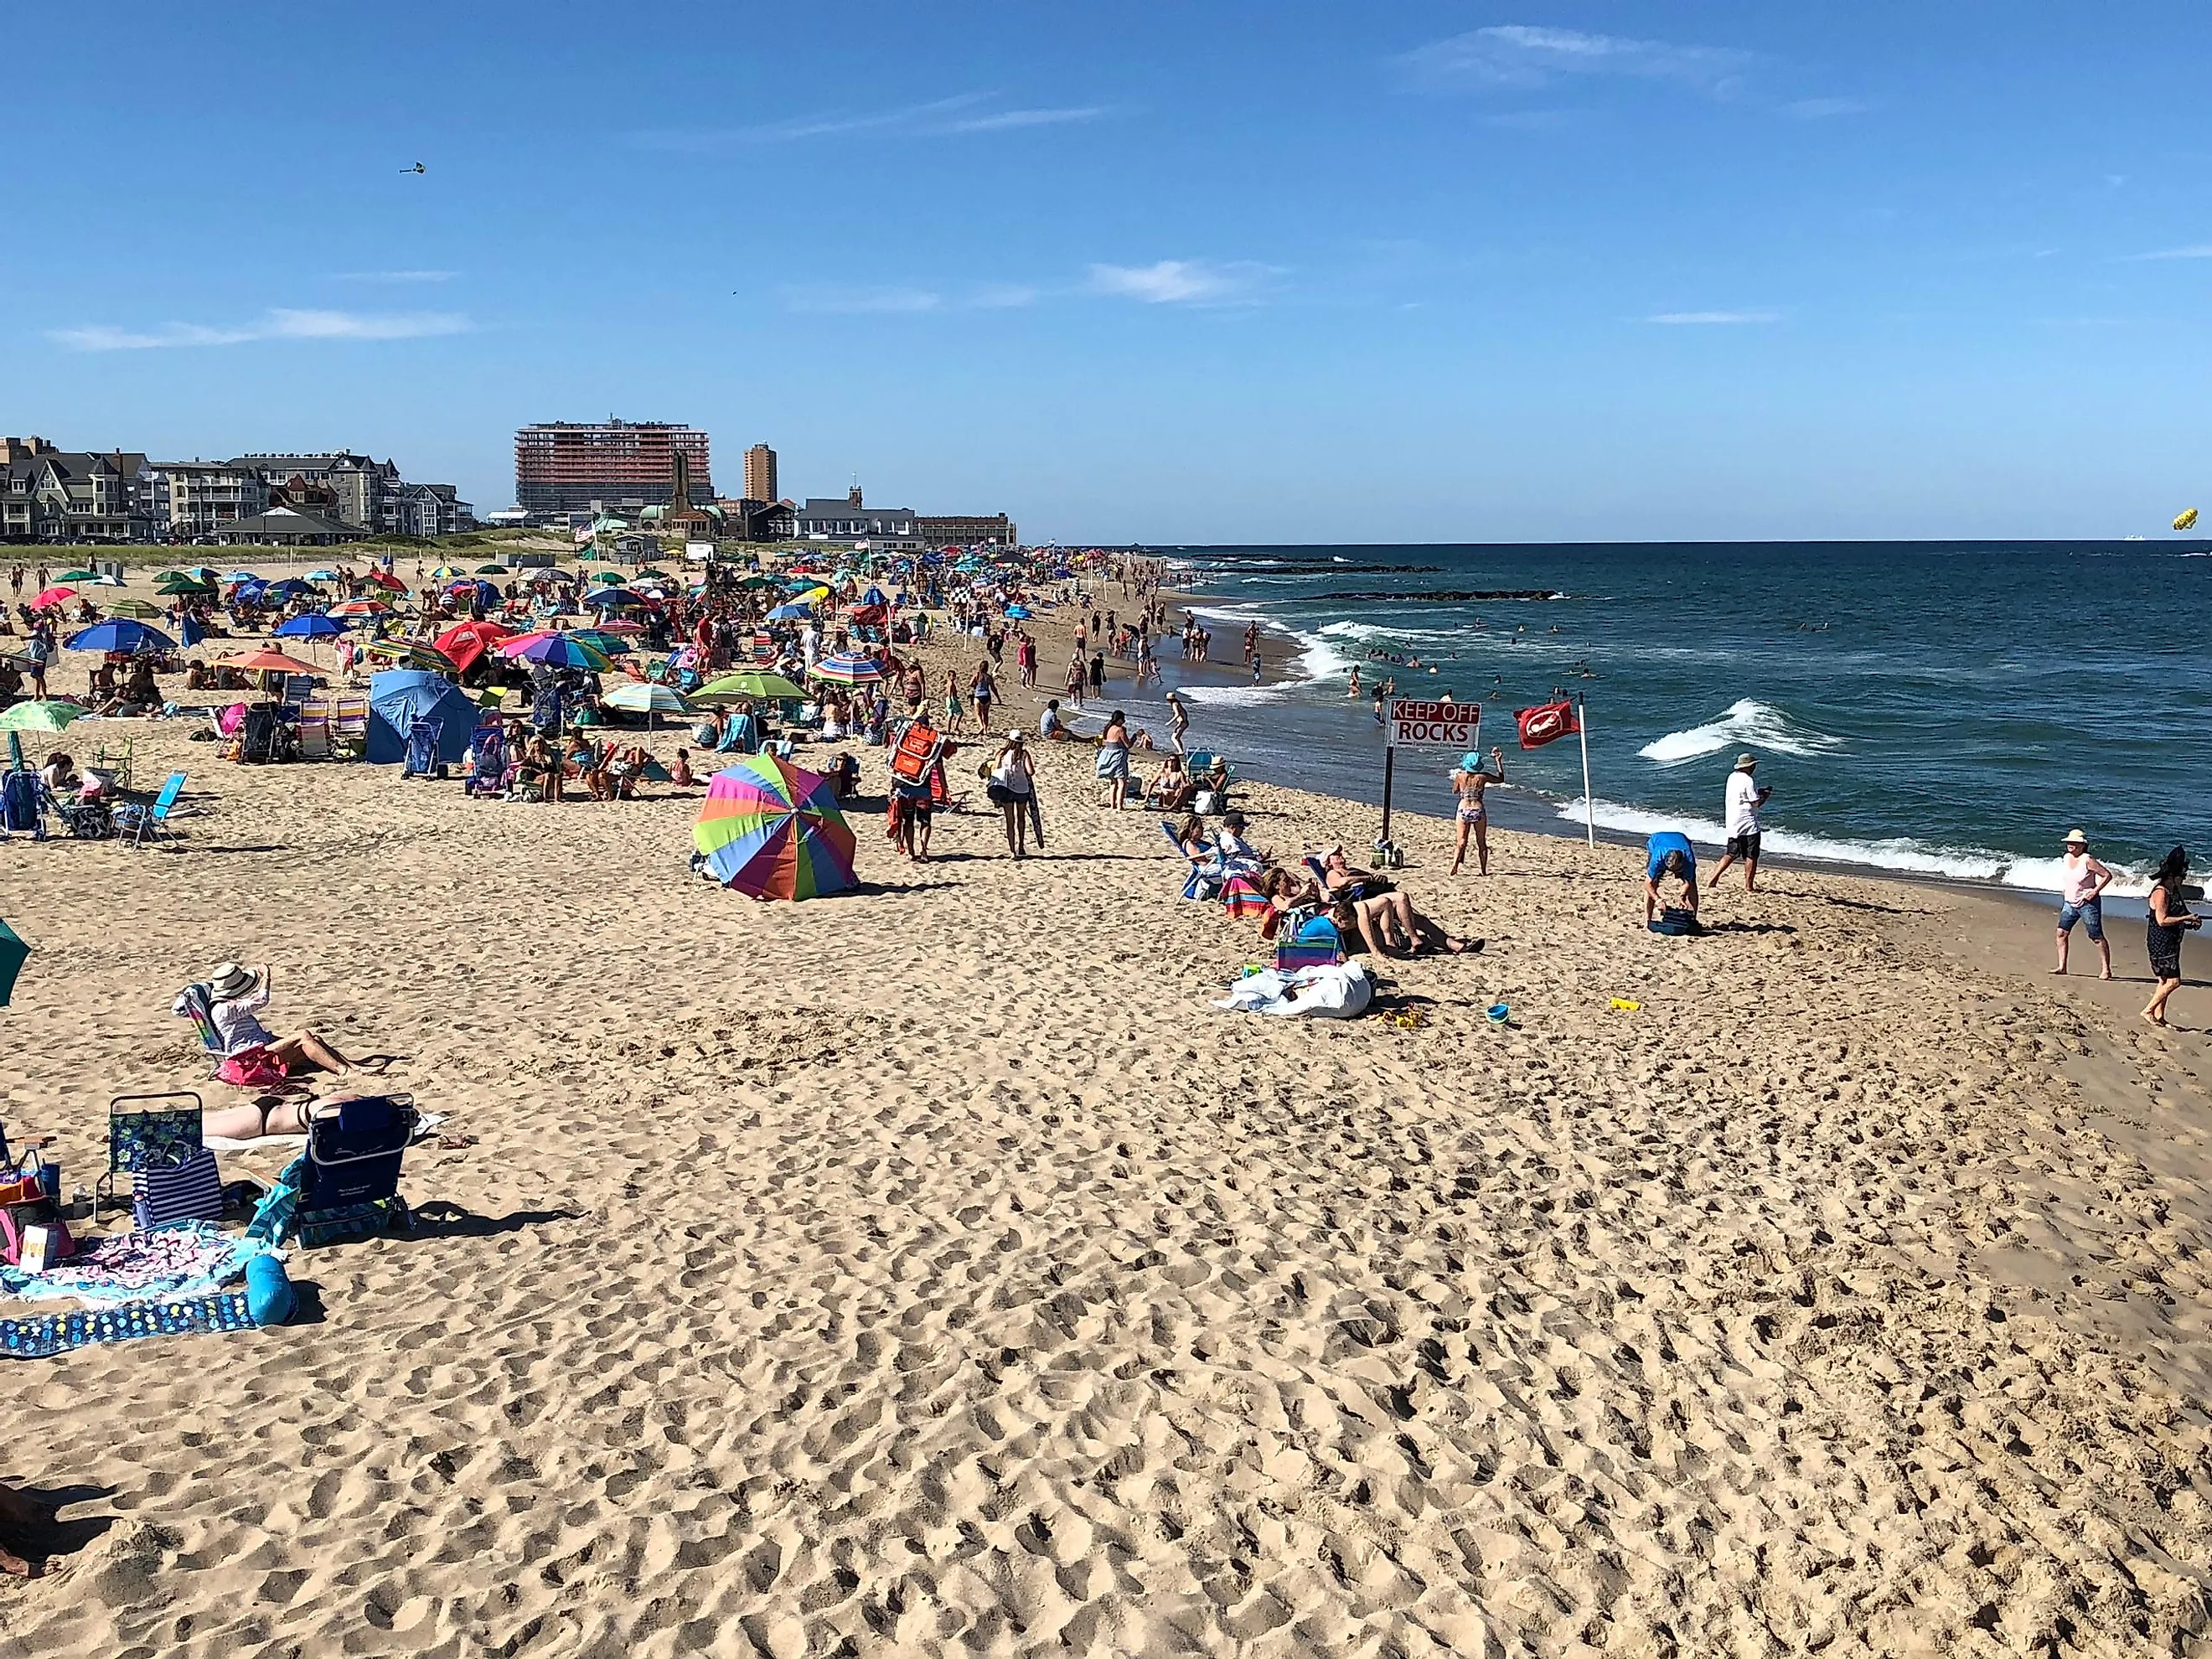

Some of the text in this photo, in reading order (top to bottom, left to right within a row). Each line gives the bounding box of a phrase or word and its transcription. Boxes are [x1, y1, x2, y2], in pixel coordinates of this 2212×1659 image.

[1392, 700, 1480, 721] KEEP OFF
[1398, 721, 1469, 742] ROCKS
